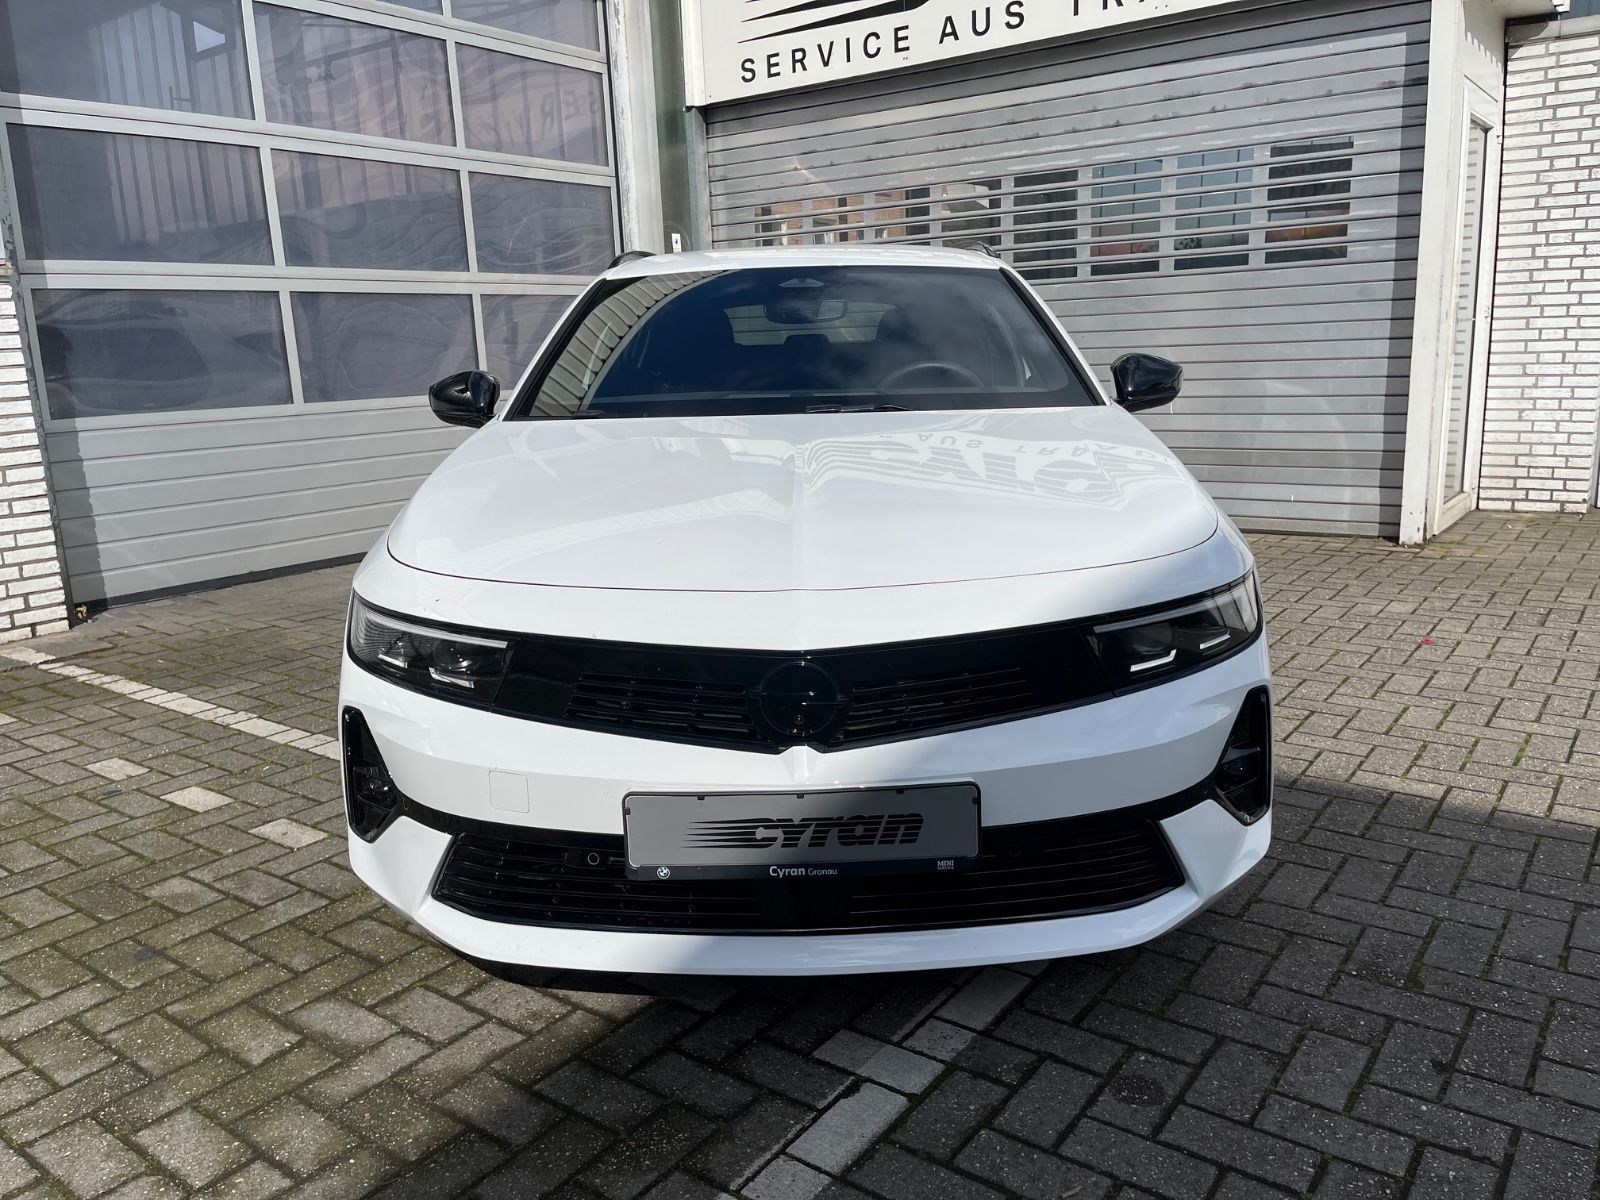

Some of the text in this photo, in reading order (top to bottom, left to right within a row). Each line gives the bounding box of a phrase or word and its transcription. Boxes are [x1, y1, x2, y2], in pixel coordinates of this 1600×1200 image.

[741, 0, 1025, 83] SERVICE AUS
[937, 859, 955, 867] MINI
[769, 865, 838, 879] Cyran Gronau
